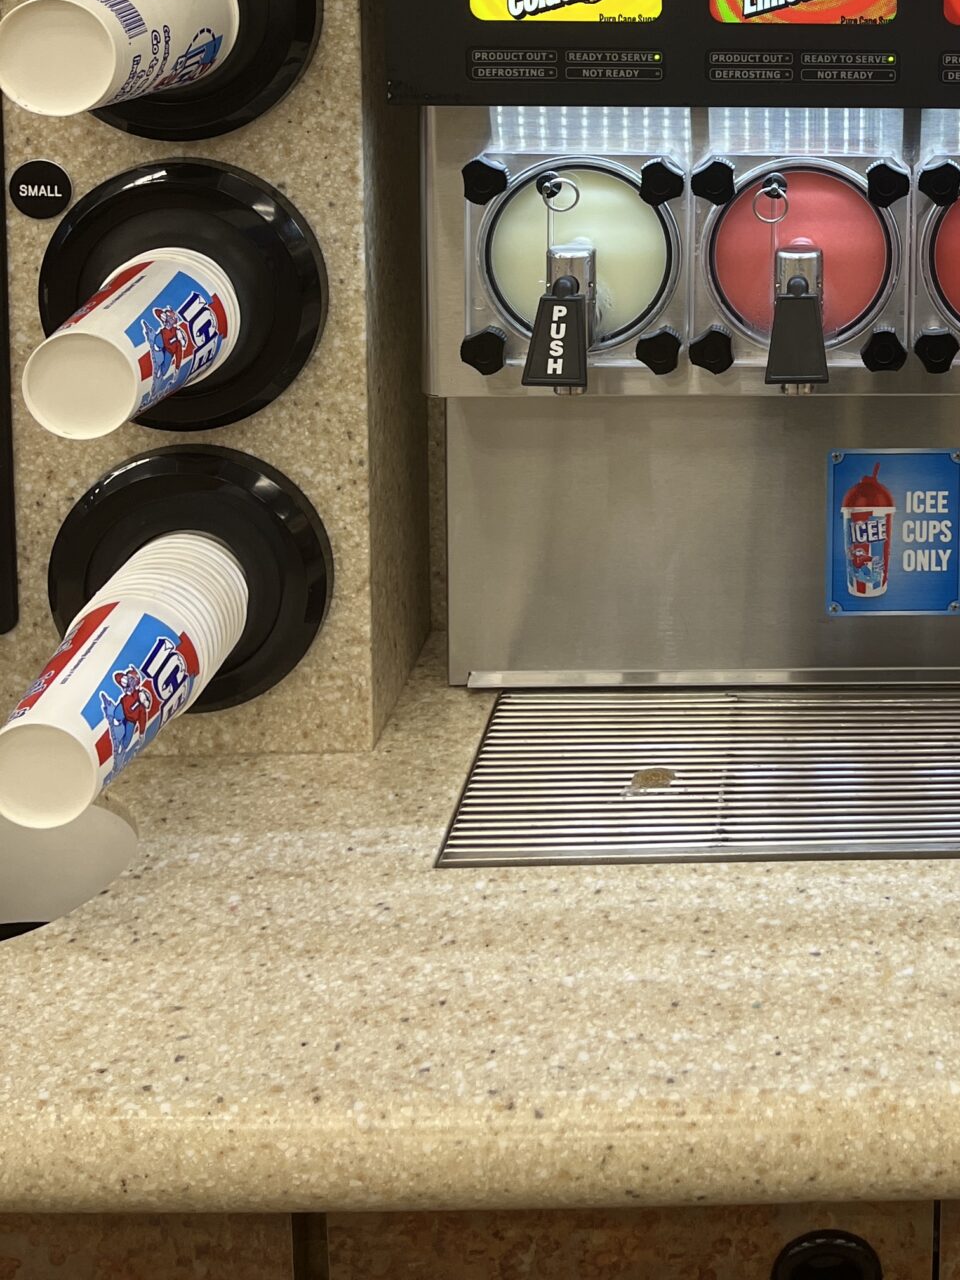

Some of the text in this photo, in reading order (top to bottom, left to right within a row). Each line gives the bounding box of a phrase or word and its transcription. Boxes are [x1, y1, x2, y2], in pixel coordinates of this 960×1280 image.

[475, 53, 546, 61] PRODUCT OUT
[569, 53, 602, 61] READY
[621, 54, 652, 62] SERVE
[712, 55, 783, 63] PRODUCT OUT
[804, 55, 887, 64] READY TO SERVE
[478, 68, 545, 77] DEFROSTING
[582, 69, 639, 78] NOT READY
[715, 71, 780, 79] DEFROSTING
[817, 71, 873, 79] NOT READY
[19, 185, 63, 197] SMALL
[547, 305, 567, 375] PUSH
[906, 491, 949, 513] ICEE
[850, 520, 888, 544] ICEE
[902, 520, 953, 543] CUPS
[902, 549, 952, 572] ONLY
